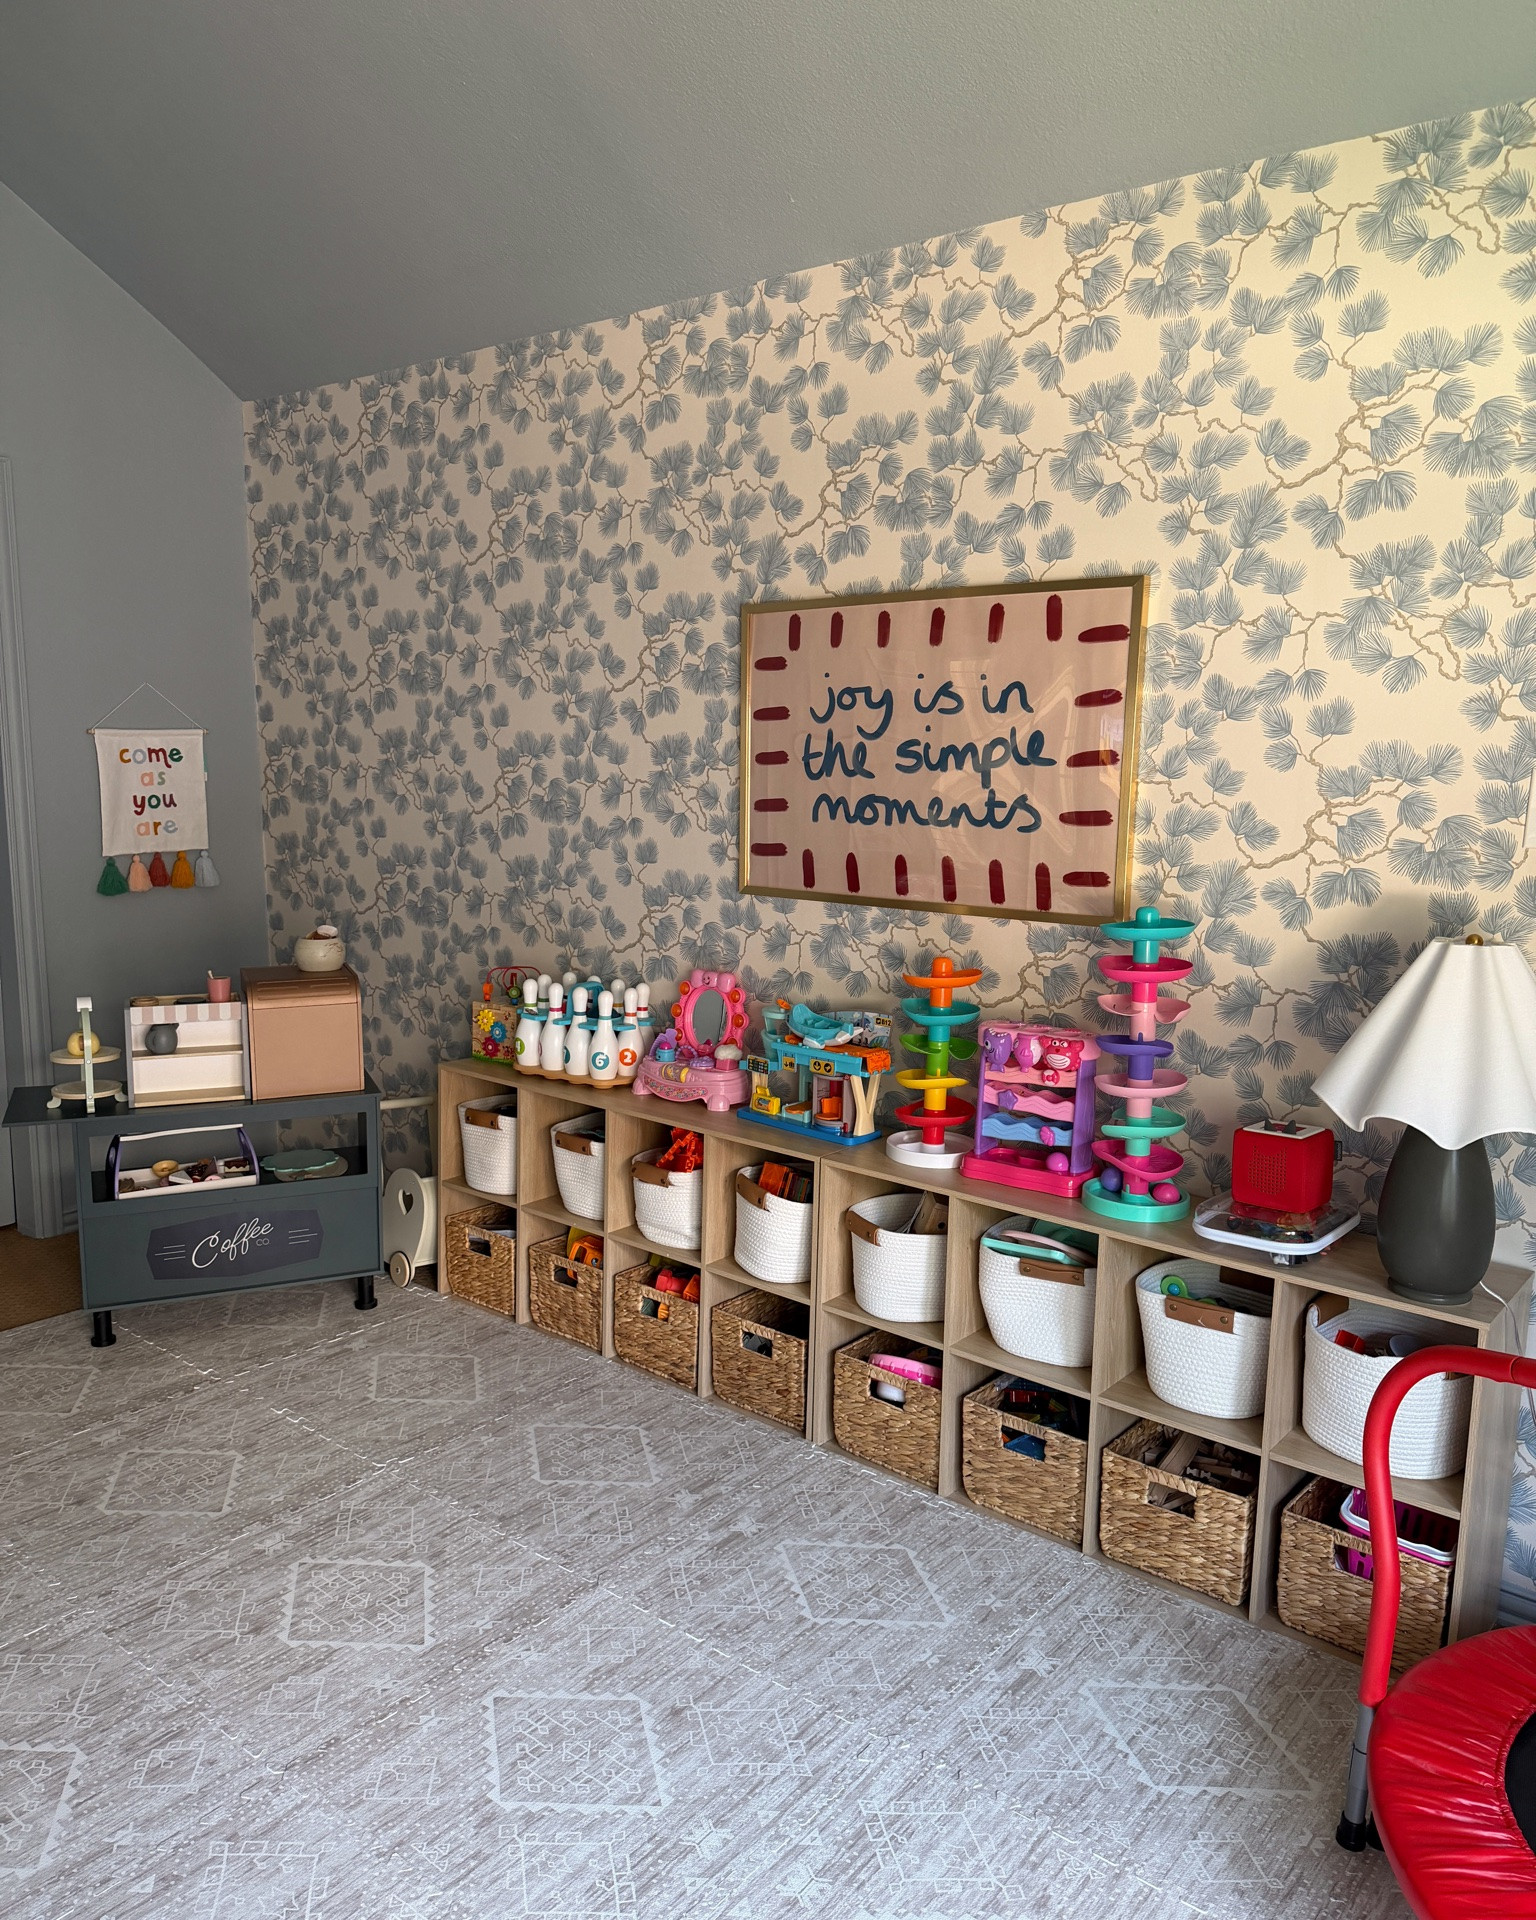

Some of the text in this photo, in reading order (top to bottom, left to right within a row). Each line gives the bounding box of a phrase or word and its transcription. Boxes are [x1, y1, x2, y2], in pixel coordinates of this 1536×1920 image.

[809, 672, 1034, 740] joy is in
[119, 747, 184, 769] come
[802, 725, 1058, 789] the simple
[140, 771, 166, 787] as
[133, 793, 178, 816] you
[811, 788, 1043, 833] moments
[136, 820, 179, 837] are
[595, 1052, 607, 1067] 6
[623, 1051, 633, 1063] 2
[191, 1217, 274, 1269] Coffee
